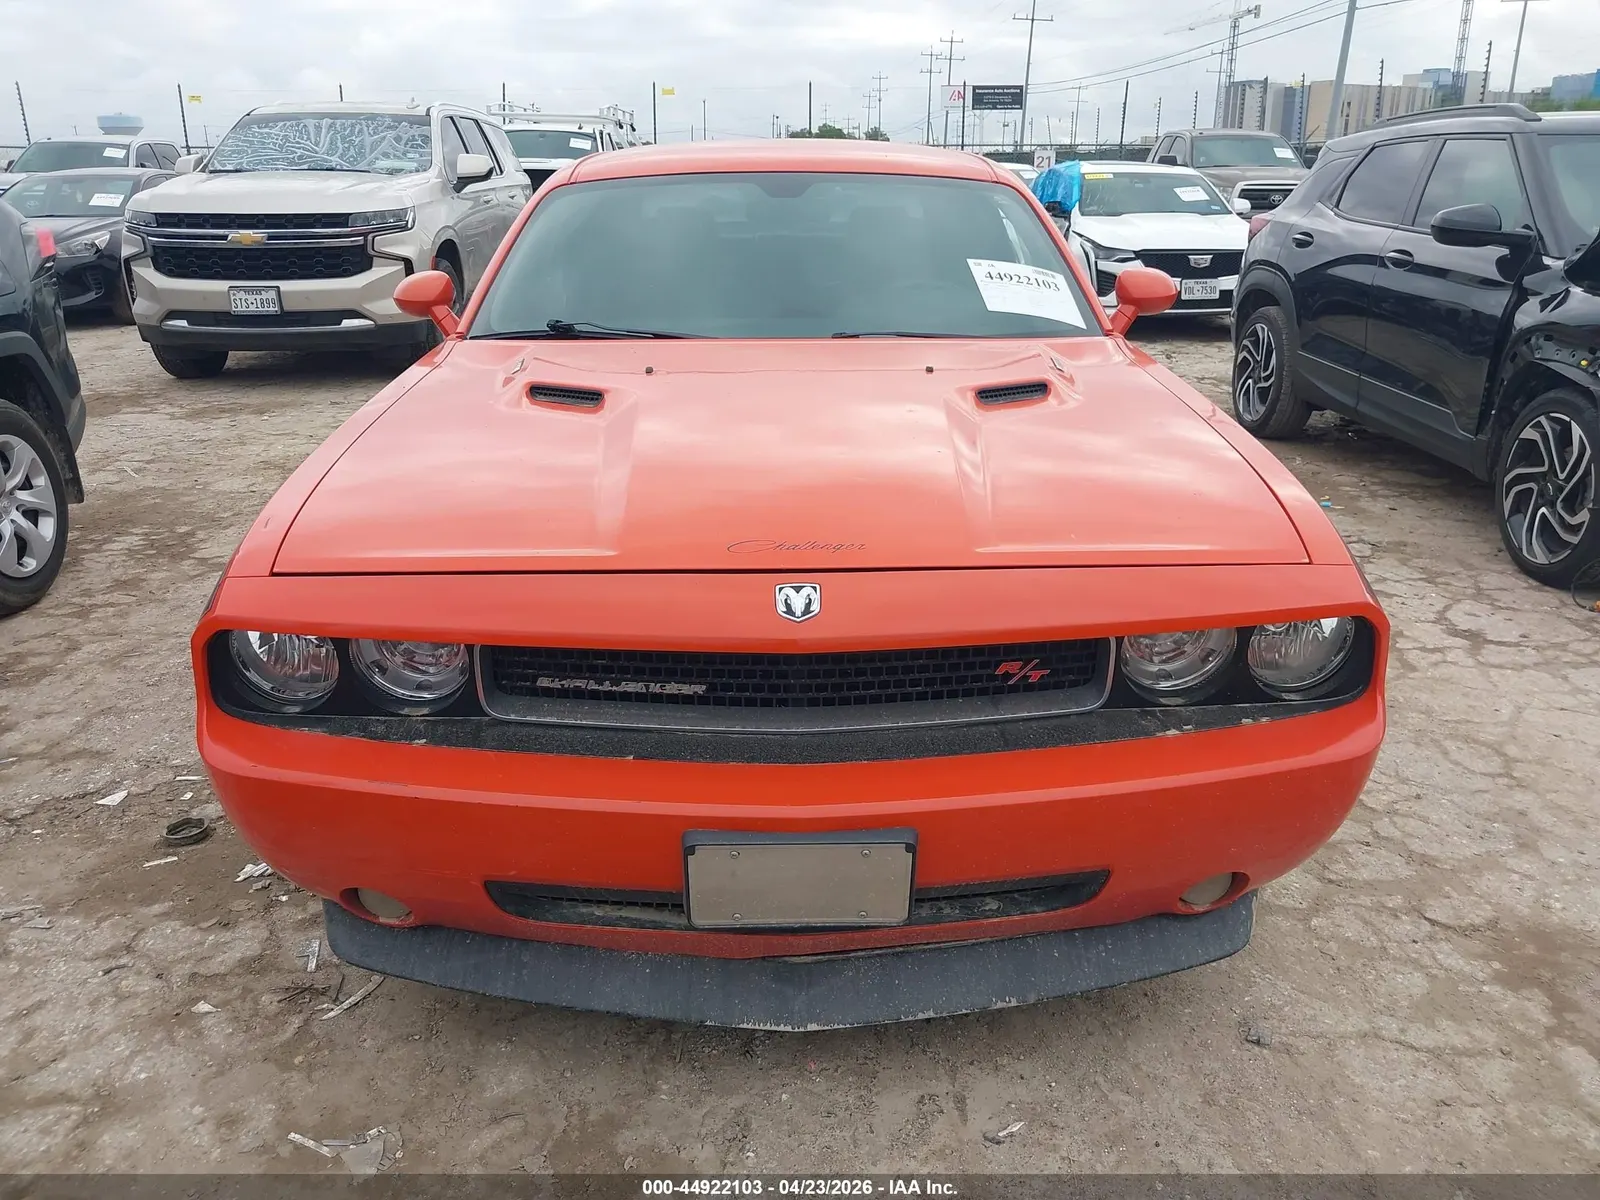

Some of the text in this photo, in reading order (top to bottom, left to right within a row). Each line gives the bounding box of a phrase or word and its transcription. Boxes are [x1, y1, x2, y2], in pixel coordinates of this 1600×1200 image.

[1036, 155, 1051, 168] 21
[984, 271, 1061, 292] 44922103
[727, 539, 867, 554] Challenger
[994, 659, 1051, 685] R/T
